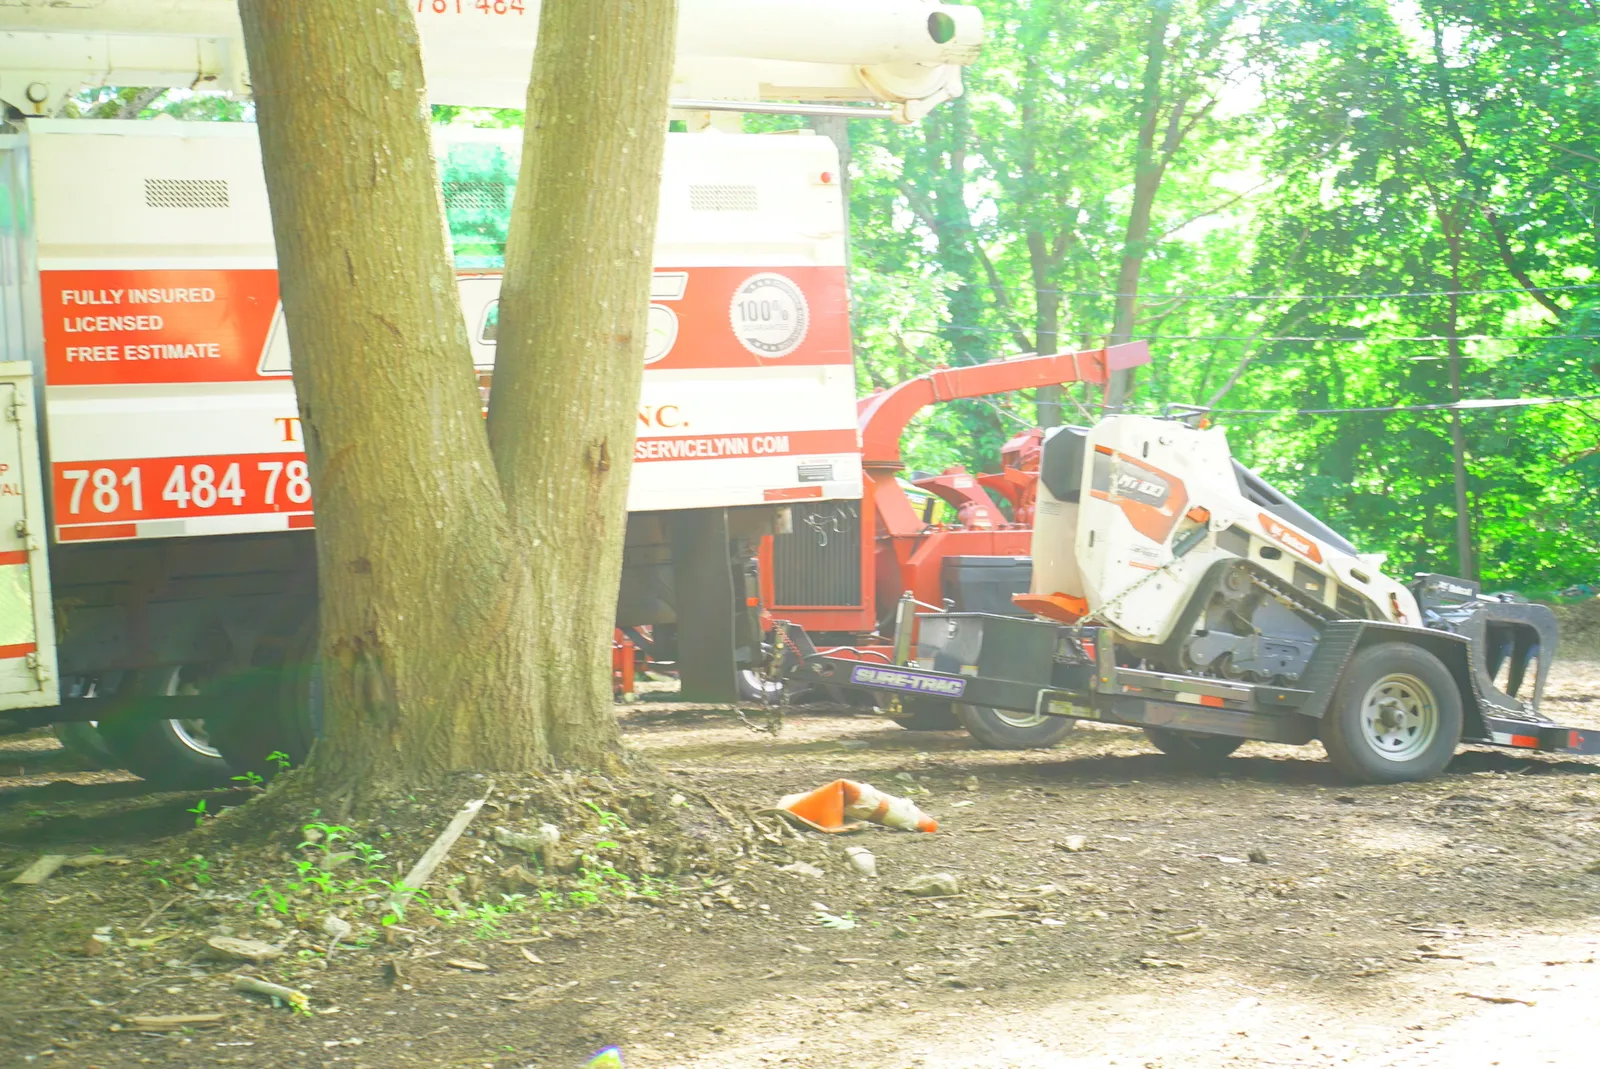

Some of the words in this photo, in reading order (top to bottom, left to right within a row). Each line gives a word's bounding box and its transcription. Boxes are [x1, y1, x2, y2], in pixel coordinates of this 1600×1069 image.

[61, 289, 124, 305] FULLY
[128, 288, 216, 304] INSURED
[737, 300, 789, 322] 100%
[63, 315, 164, 333] LICENSED
[66, 346, 120, 362] FREE
[124, 343, 221, 361] ESTIMATE
[633, 437, 749, 459] SERVICELYNN
[63, 467, 143, 515] 781
[162, 463, 246, 509] 484
[257, 460, 312, 504] 78
